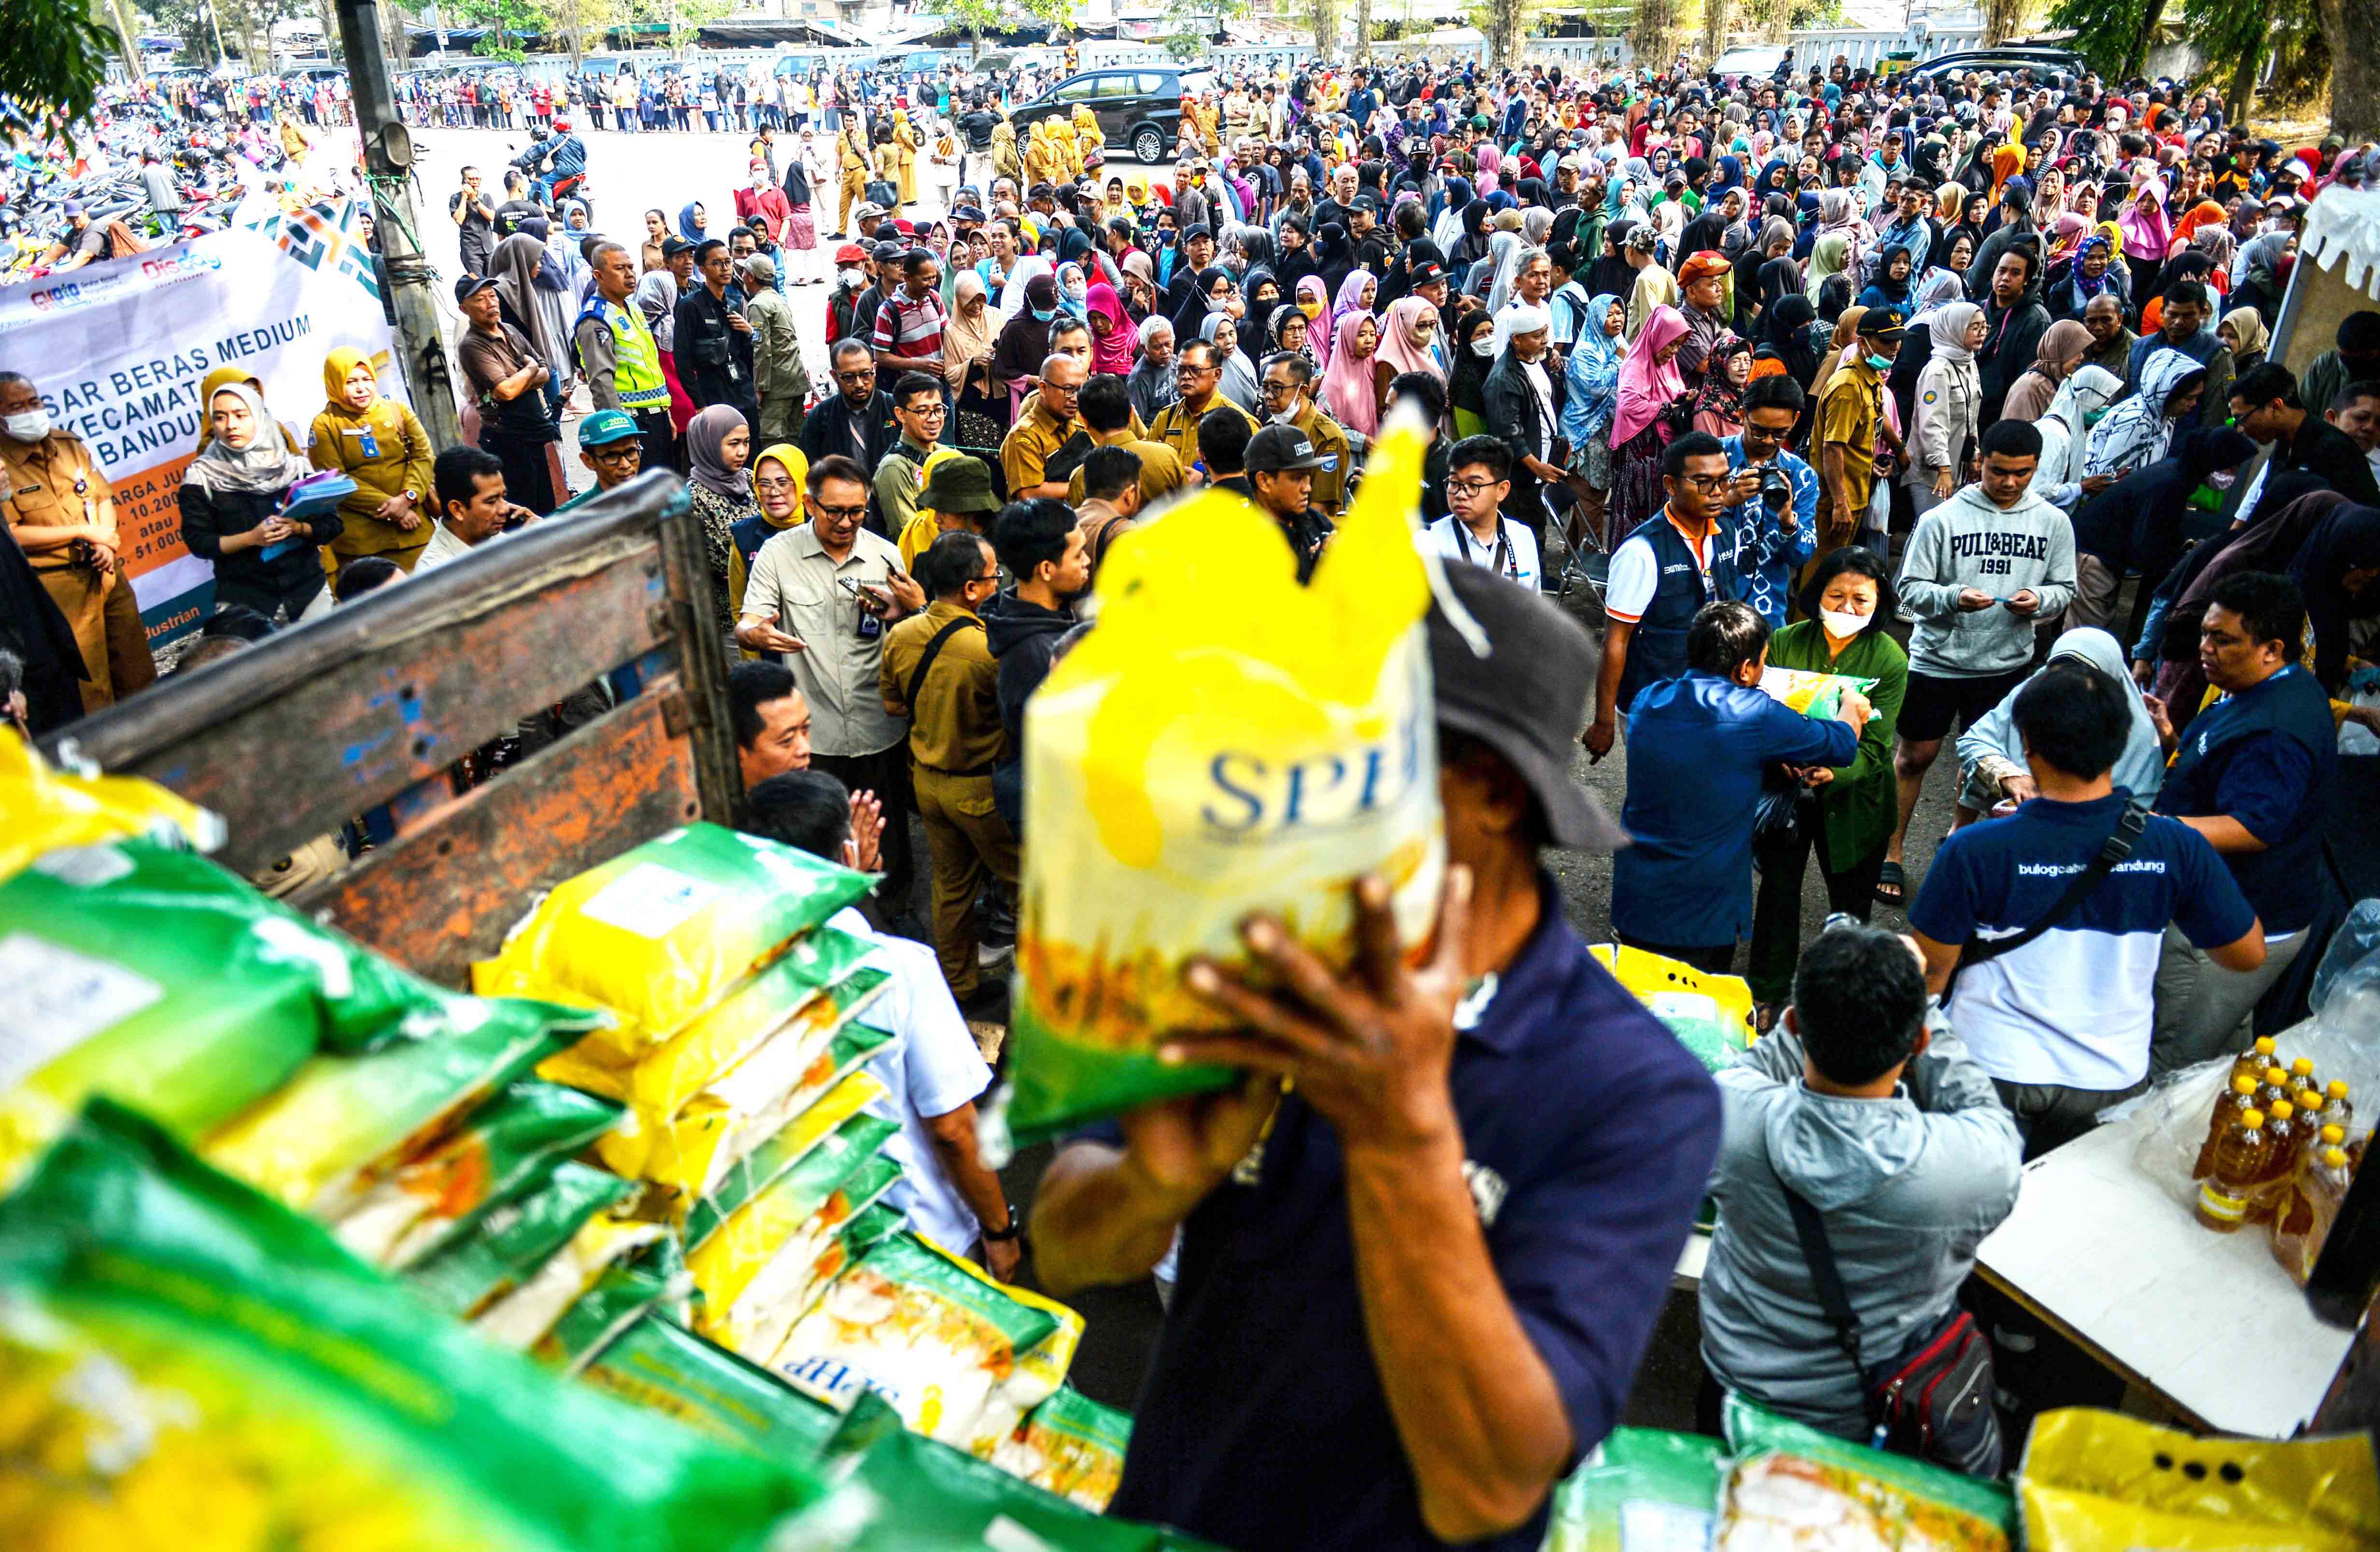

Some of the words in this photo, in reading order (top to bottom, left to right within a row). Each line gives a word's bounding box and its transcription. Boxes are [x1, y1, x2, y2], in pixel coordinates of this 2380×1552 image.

[110, 348, 209, 396] BERAS
[216, 314, 312, 363] MEDIUM
[140, 517, 173, 538] atau
[1980, 559, 2012, 575] 1991
